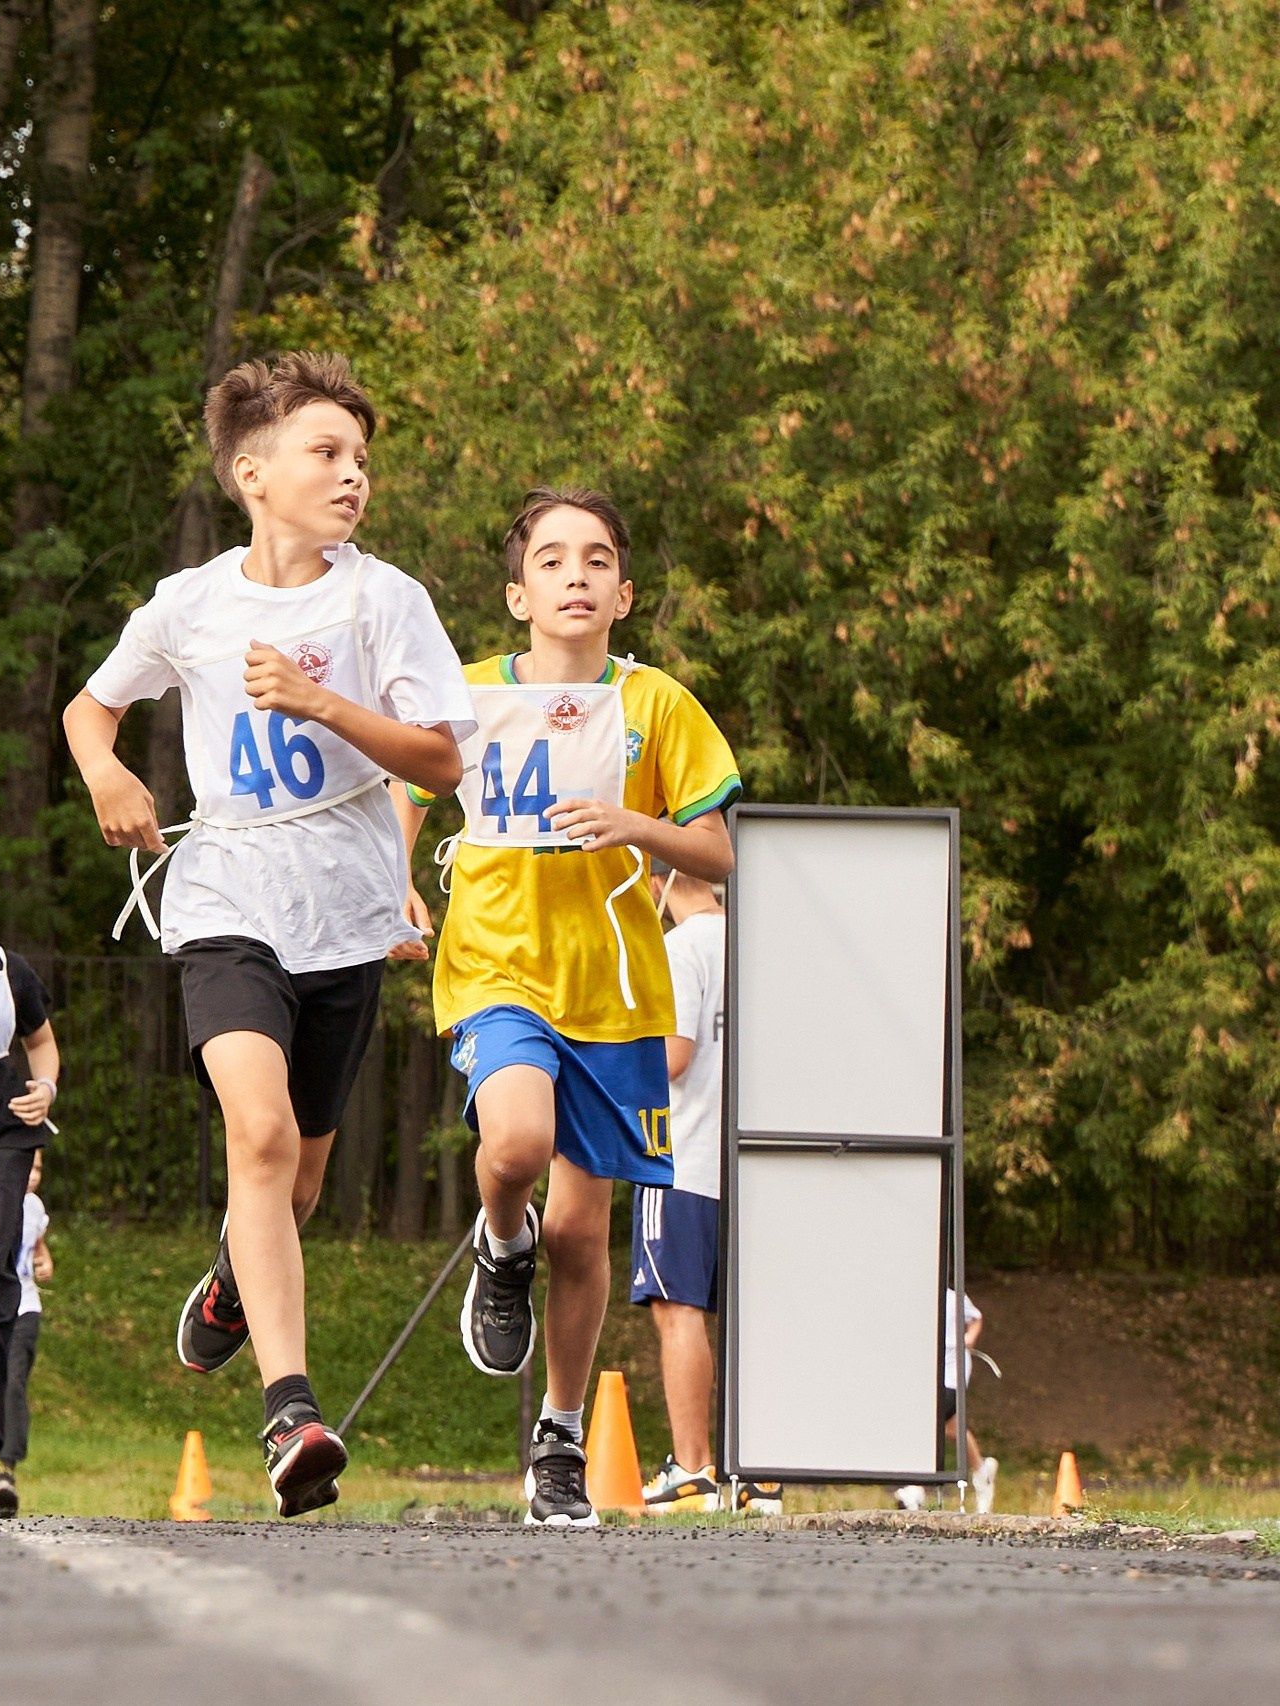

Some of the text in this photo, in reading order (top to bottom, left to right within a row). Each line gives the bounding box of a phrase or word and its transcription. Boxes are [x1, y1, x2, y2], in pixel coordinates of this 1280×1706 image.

[230, 710, 324, 809] 46
[481, 739, 557, 833] 44
[638, 1107, 671, 1157] 10
